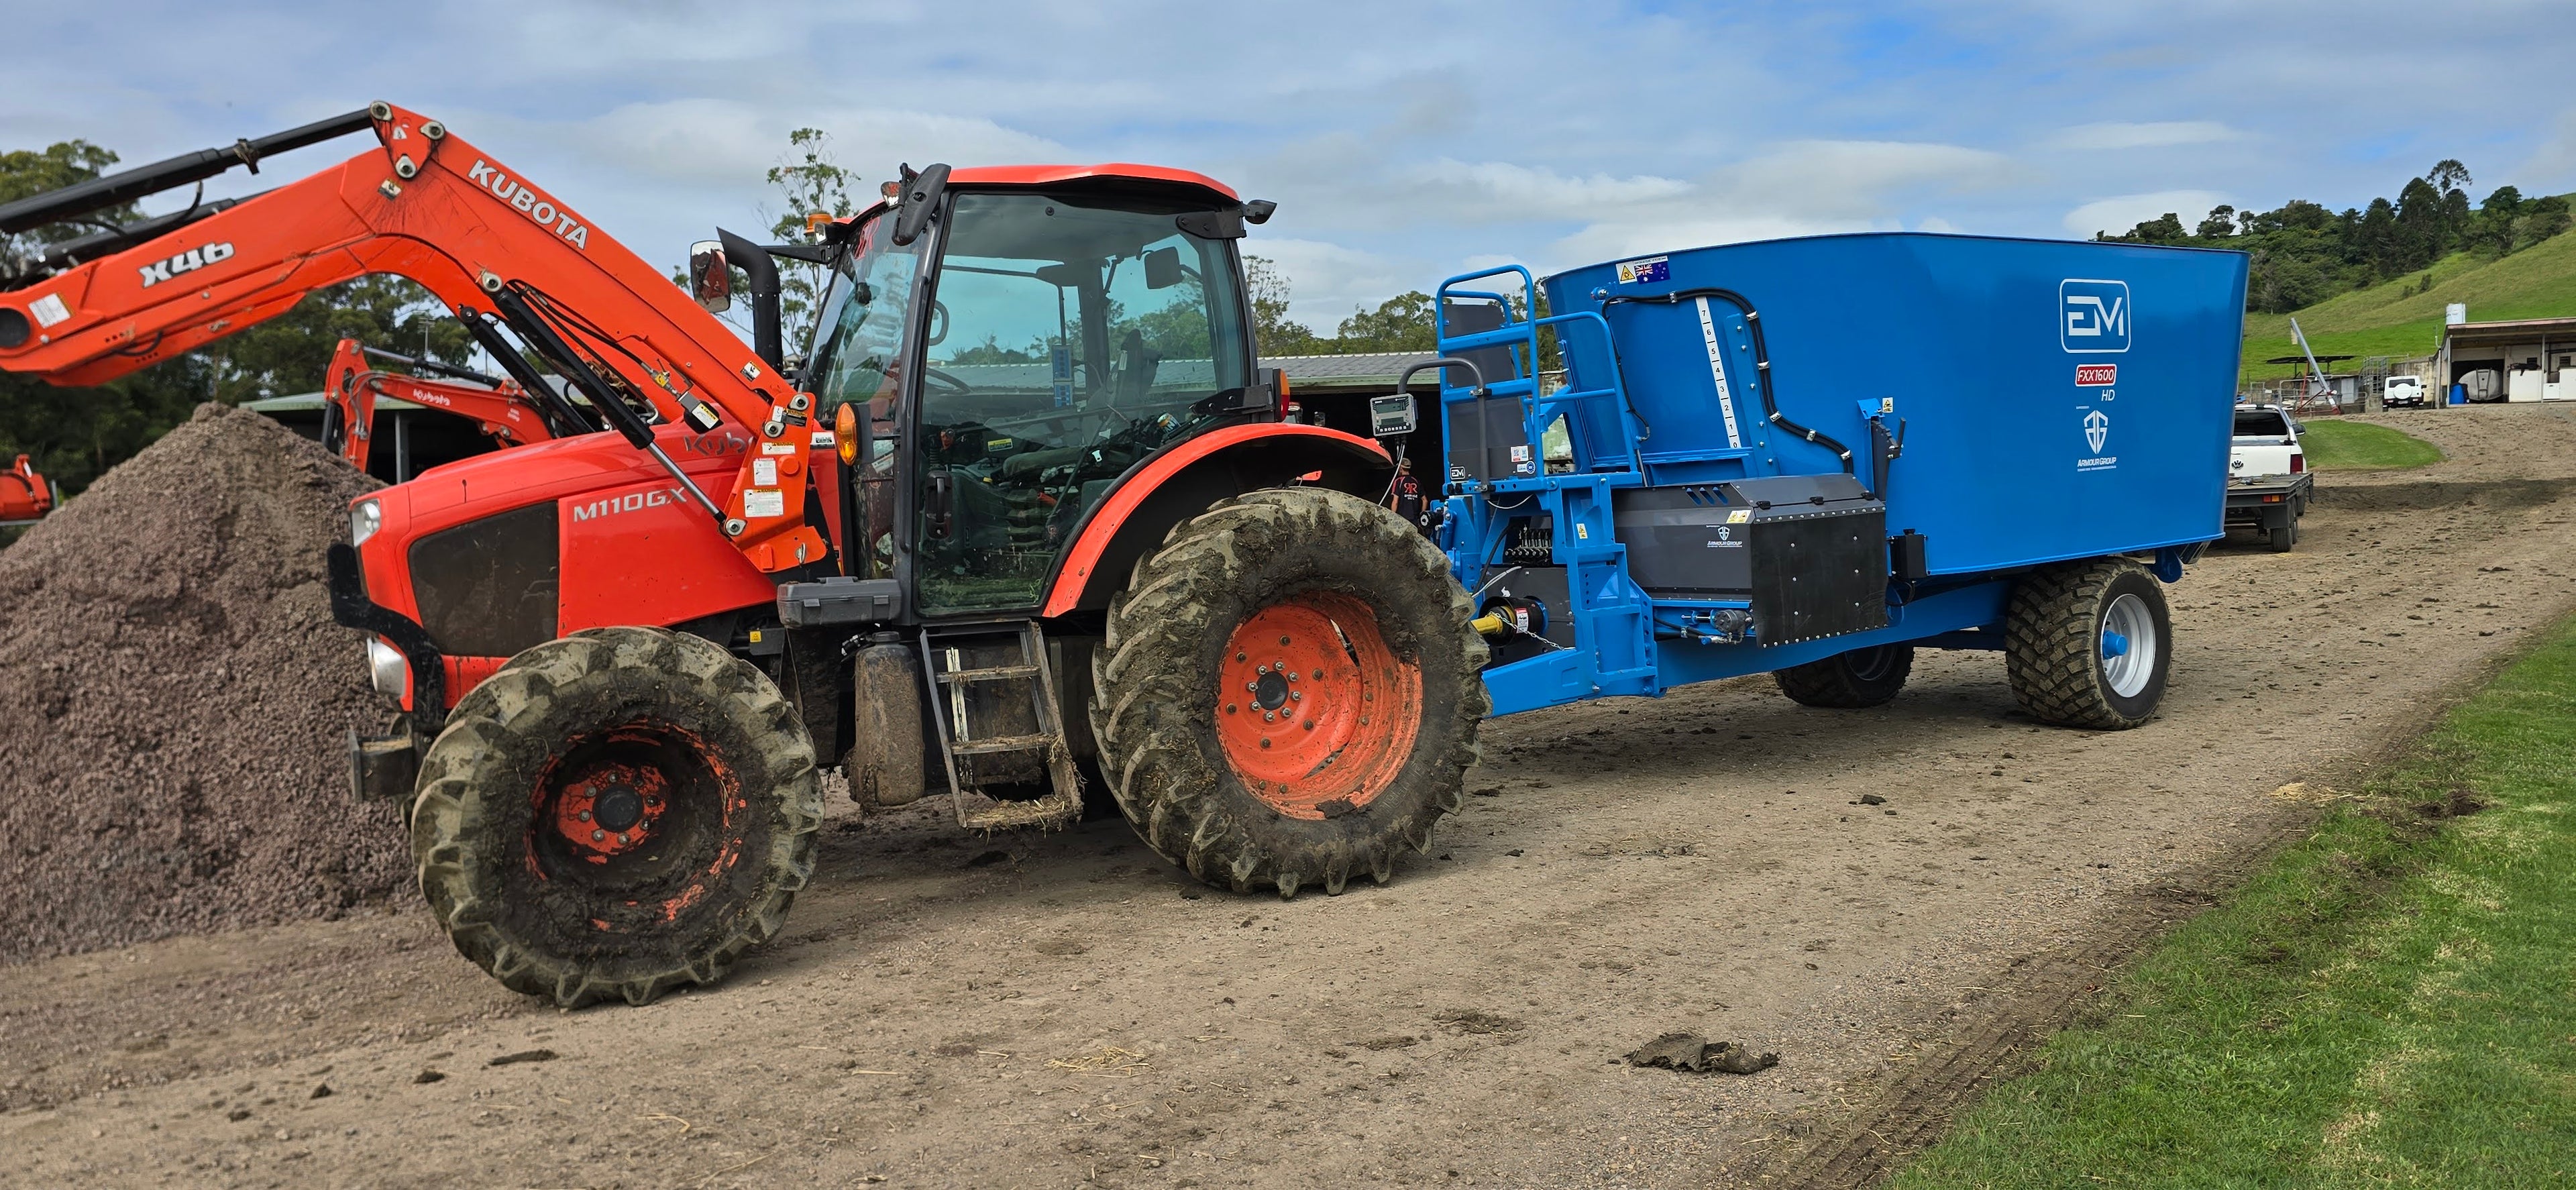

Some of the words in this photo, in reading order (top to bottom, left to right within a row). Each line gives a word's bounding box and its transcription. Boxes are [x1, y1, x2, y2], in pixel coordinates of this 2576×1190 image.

[468, 158, 588, 250] KUBOTA
[139, 242, 234, 288] X46
[2067, 295, 2125, 336] EM
[2078, 369, 2114, 382] FXX1600
[2101, 389, 2116, 401] HD
[684, 432, 753, 456] Kub
[574, 486, 687, 523] M110GX
